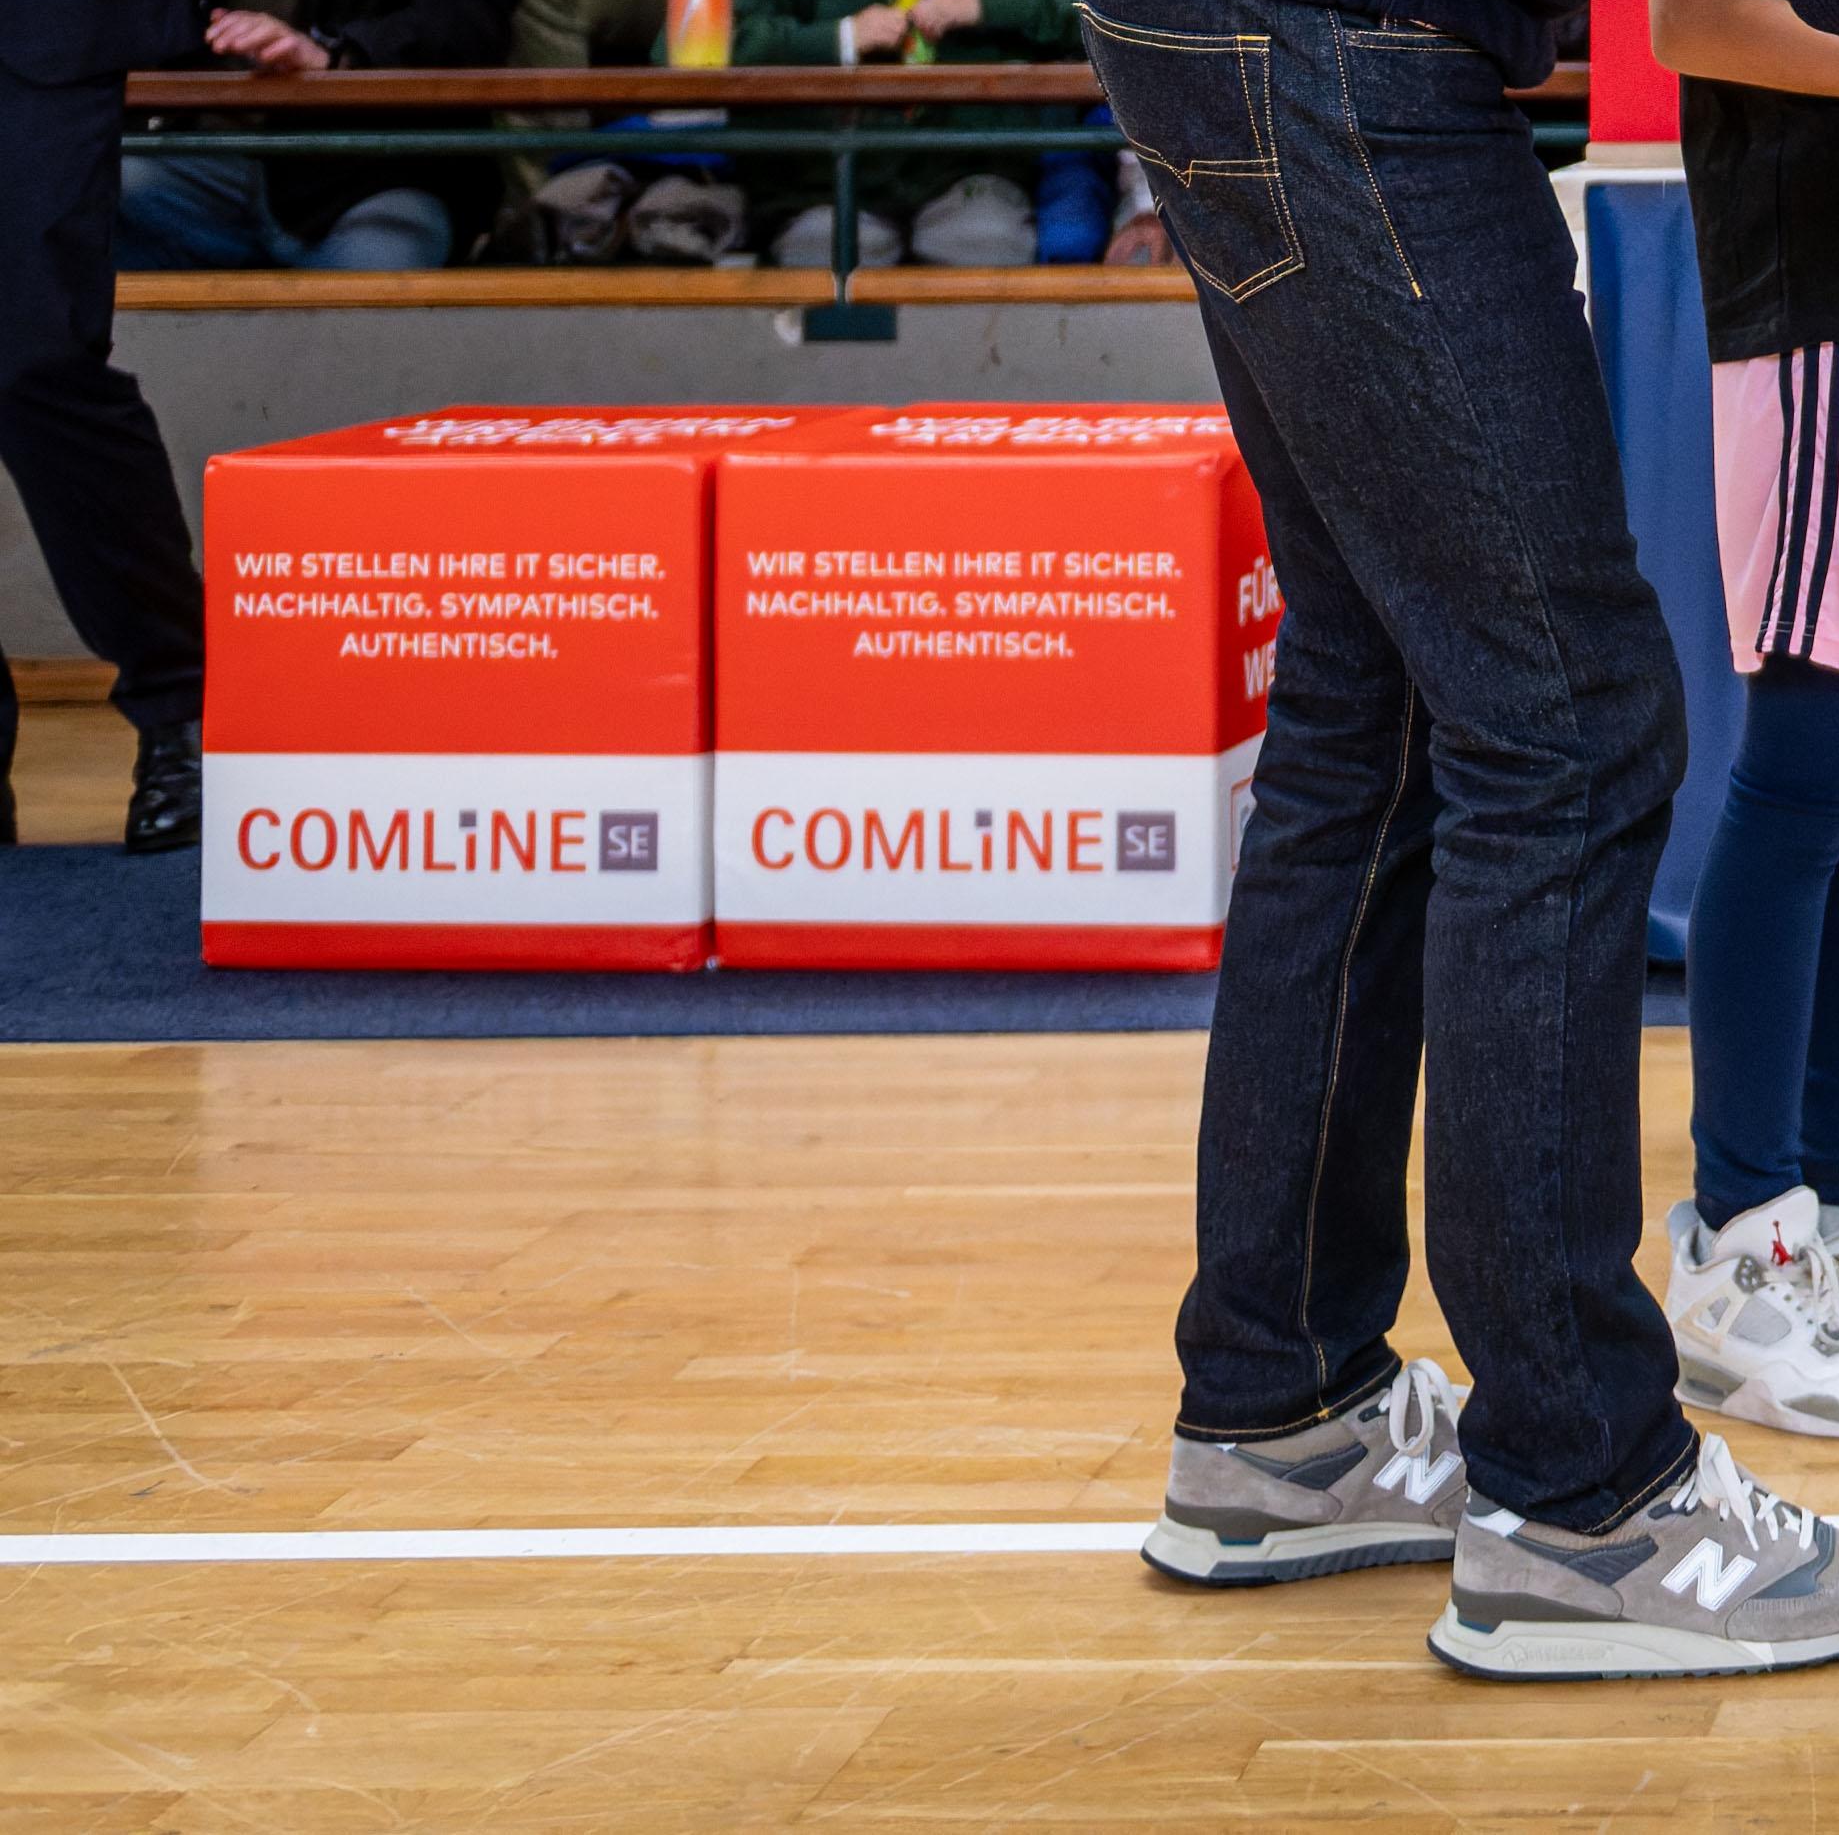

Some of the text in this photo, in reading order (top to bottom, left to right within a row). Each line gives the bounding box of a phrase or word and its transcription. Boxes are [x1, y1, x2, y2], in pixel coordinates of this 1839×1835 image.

[235, 552, 666, 581] WIR STELLEN IHRE IT SICHER.
[746, 550, 1183, 579] WIR STELLEN IHRE IT SICHER.
[234, 592, 659, 621] NACHHALTIG. SYMPATHISCH.
[746, 590, 1176, 619] NACHHALTIG. SYMPATHISCH.
[340, 631, 558, 659] AUTHENTISCH.
[853, 630, 1074, 659] AUTHENTISCH.
